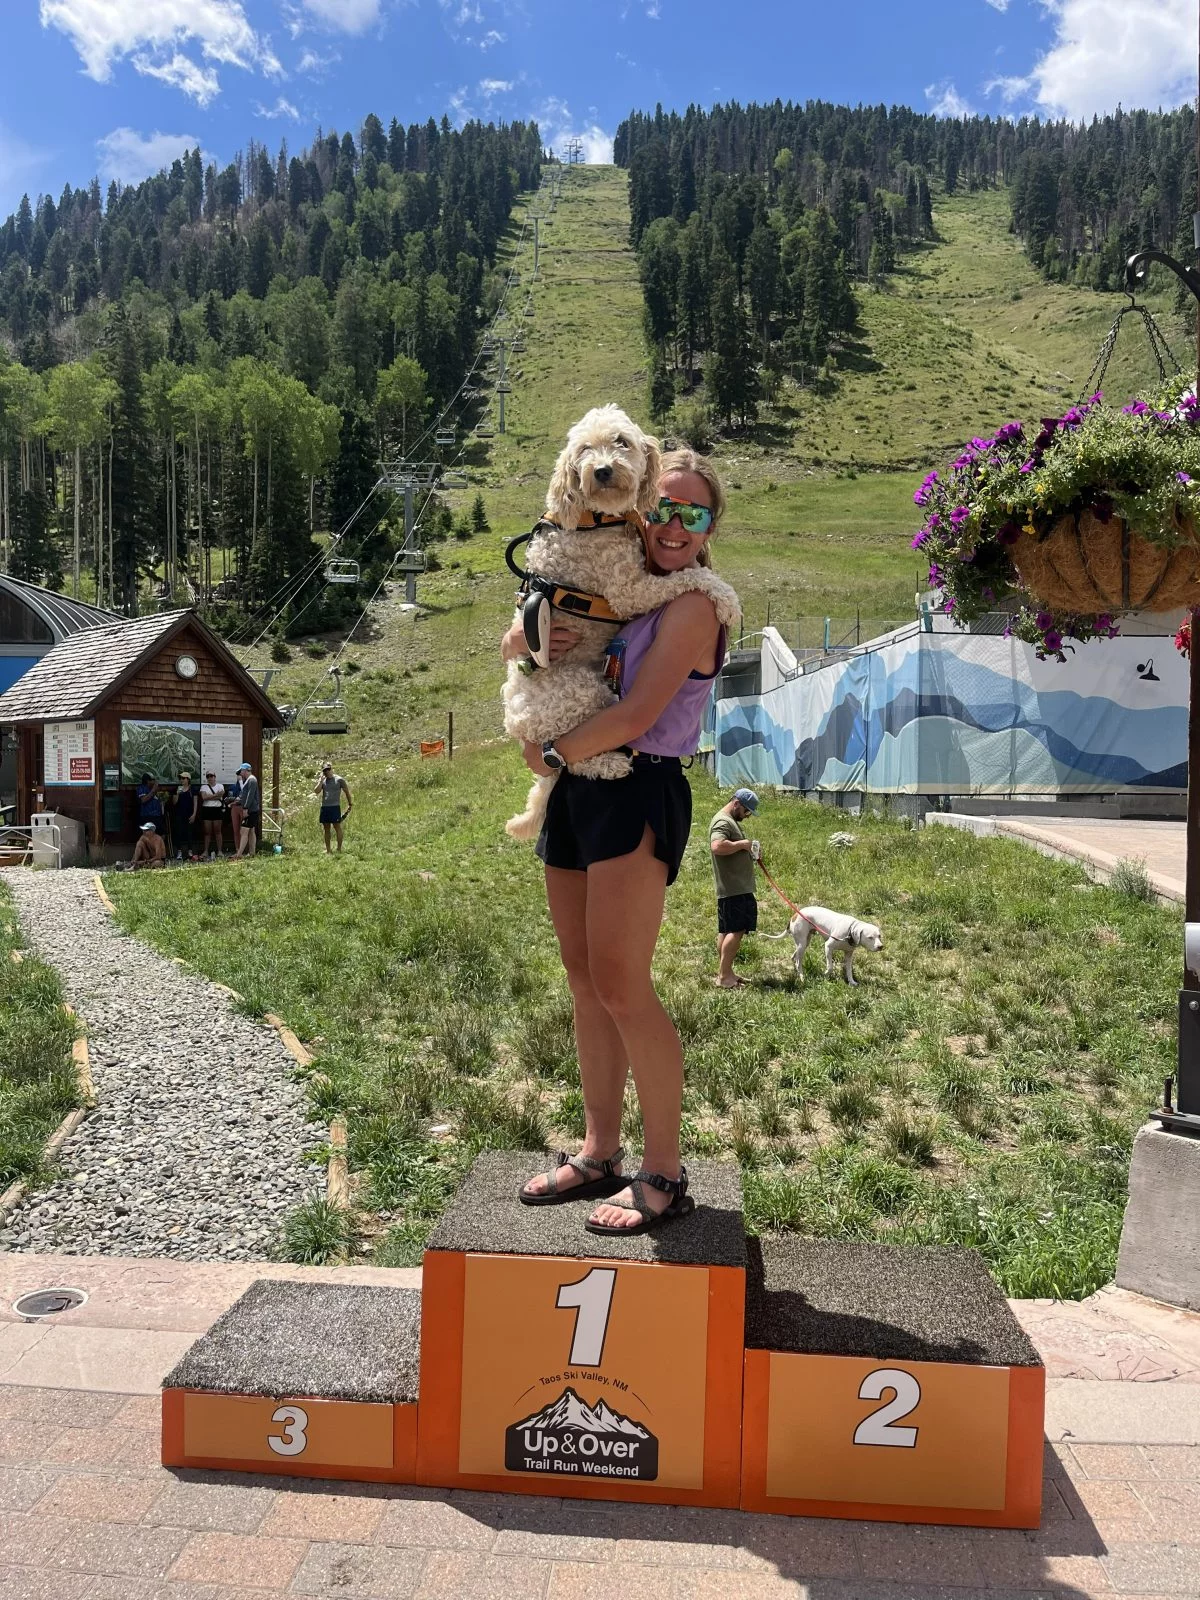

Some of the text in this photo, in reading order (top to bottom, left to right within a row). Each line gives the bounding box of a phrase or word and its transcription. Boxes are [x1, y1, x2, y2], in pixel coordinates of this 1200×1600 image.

[554, 1266, 618, 1368] 1
[539, 1371, 629, 1391] Taos Ski Valley, NM
[267, 1405, 309, 1457] 3
[852, 1368, 922, 1448] 2
[524, 1457, 639, 1477] Trail Run Weekend
